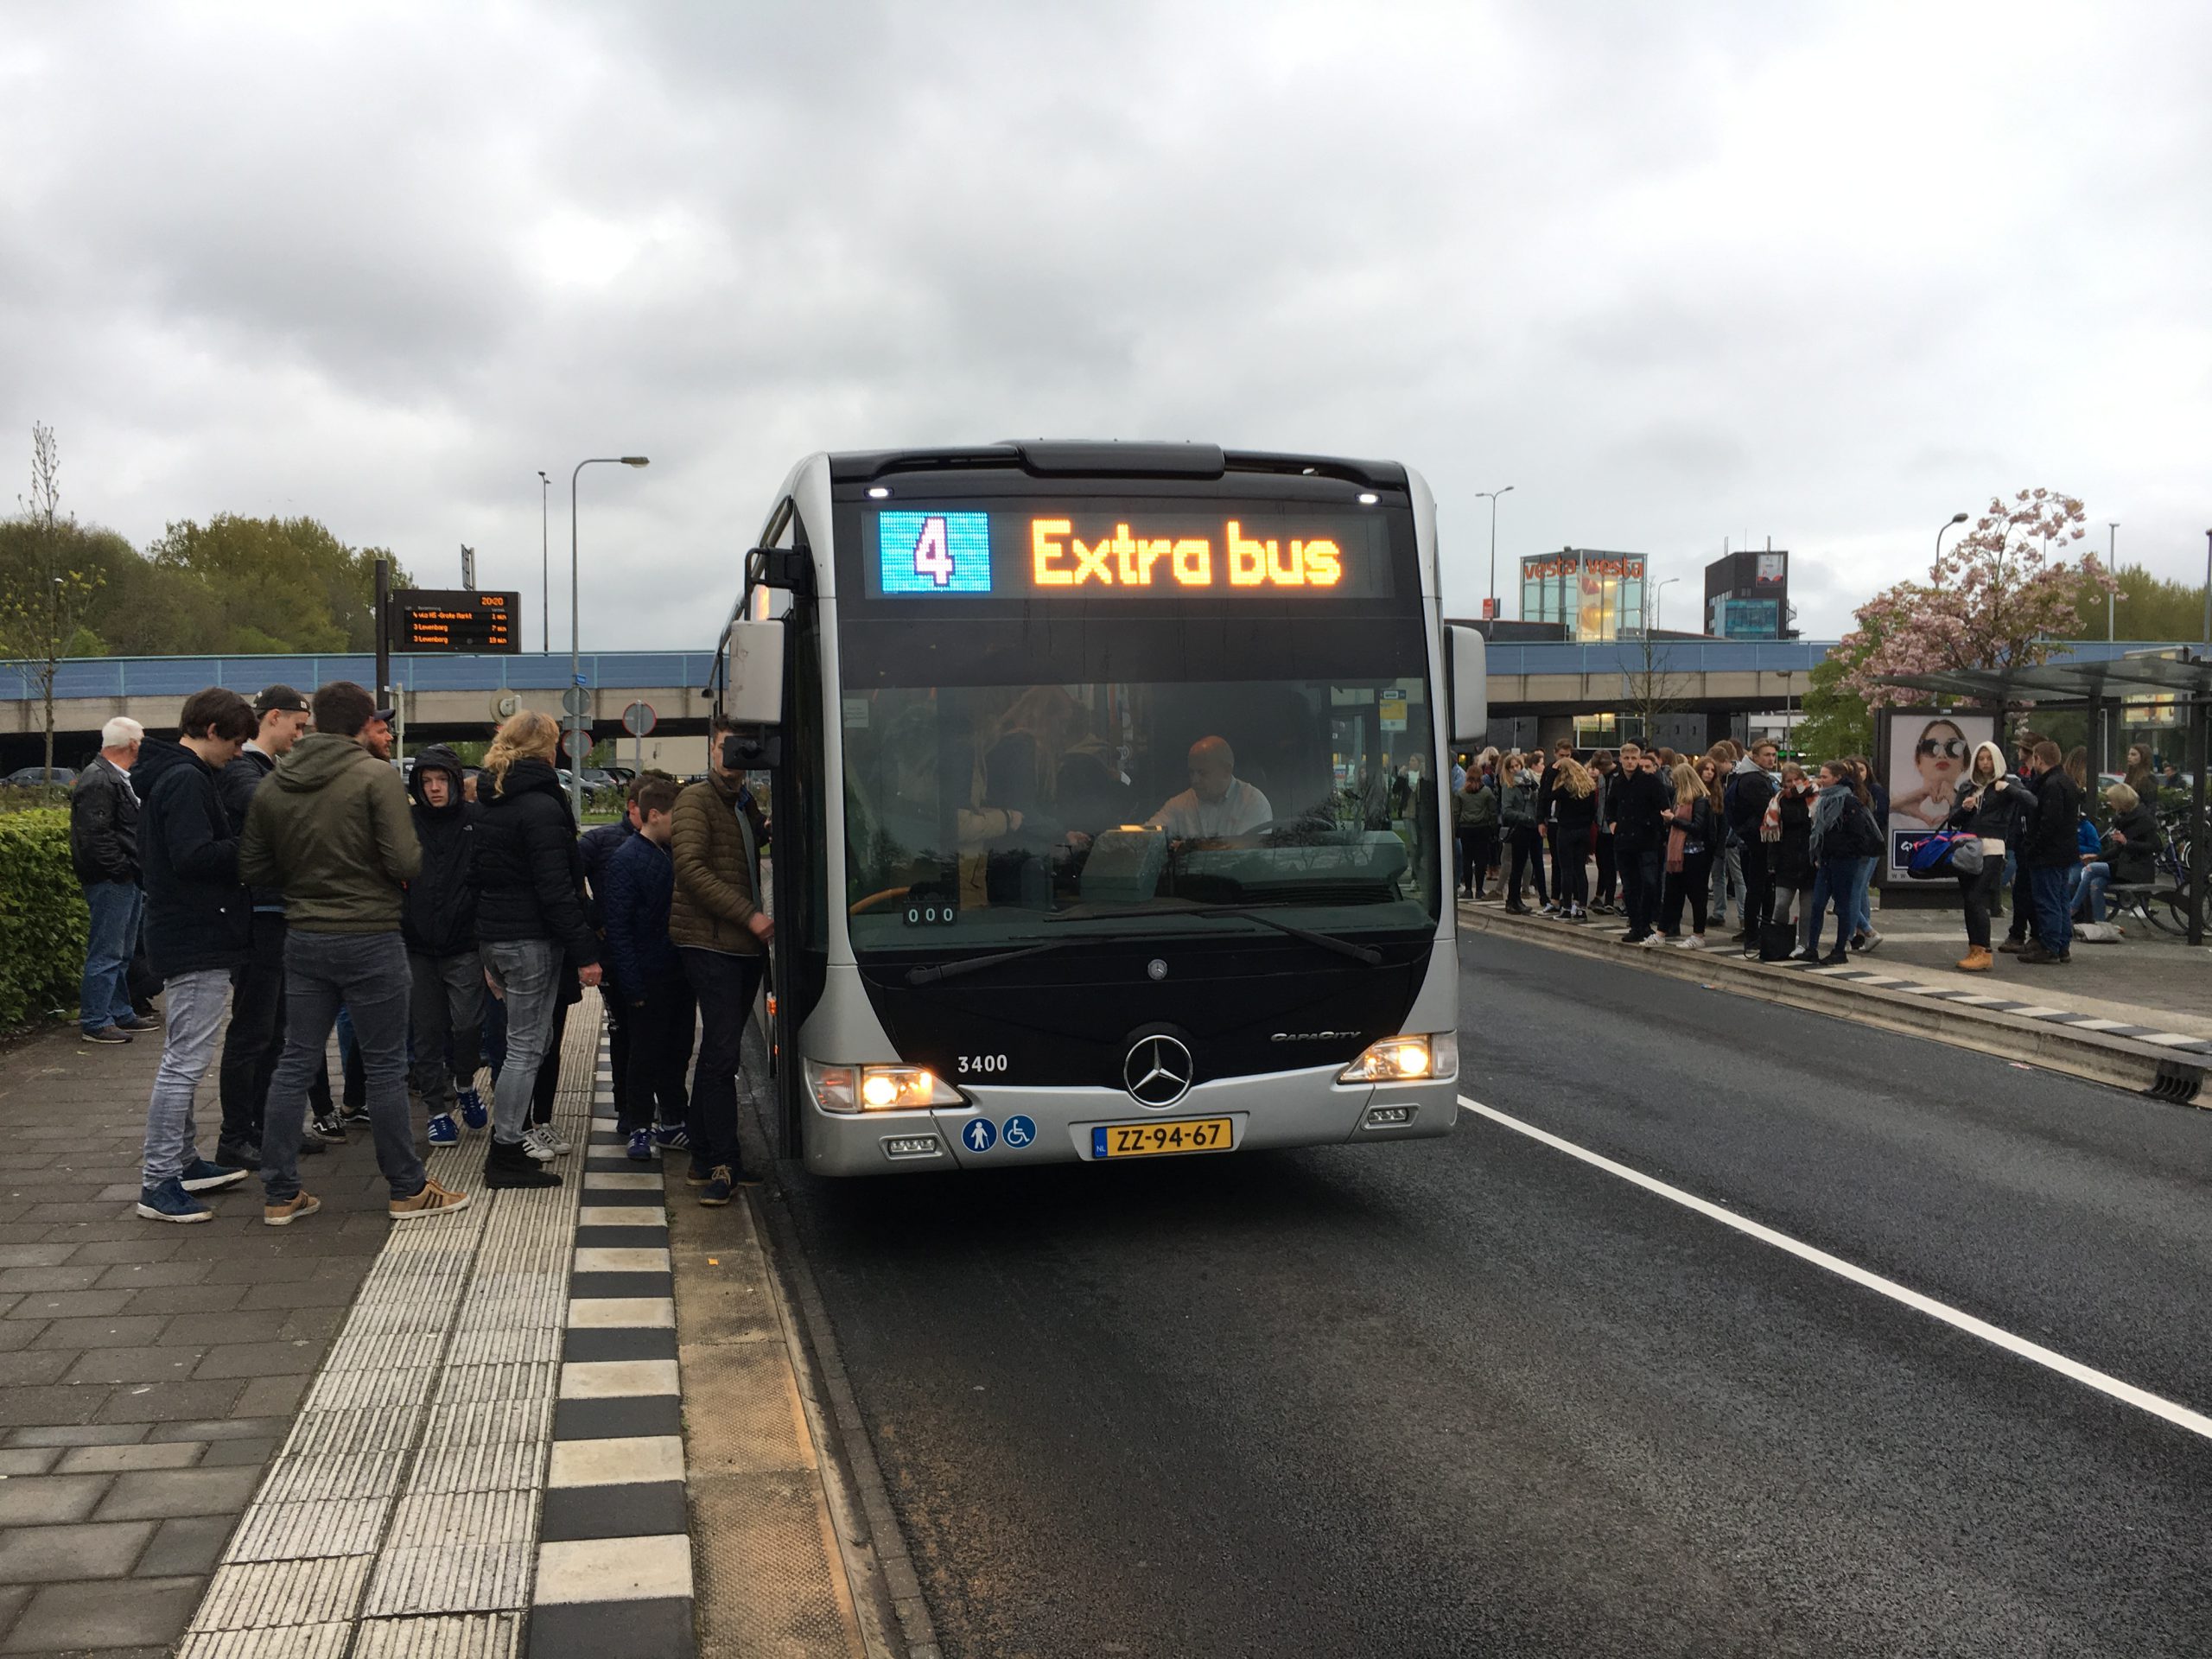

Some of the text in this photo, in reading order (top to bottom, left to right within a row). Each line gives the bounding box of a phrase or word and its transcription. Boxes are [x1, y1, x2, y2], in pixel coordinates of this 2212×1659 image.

[914, 517, 1342, 587] 4 Extra bus
[1523, 555, 1577, 581] vesta
[1586, 556, 1643, 579] vesta
[957, 1054, 1008, 1073] 3400
[1117, 1124, 1220, 1152] ZZ-94-67
